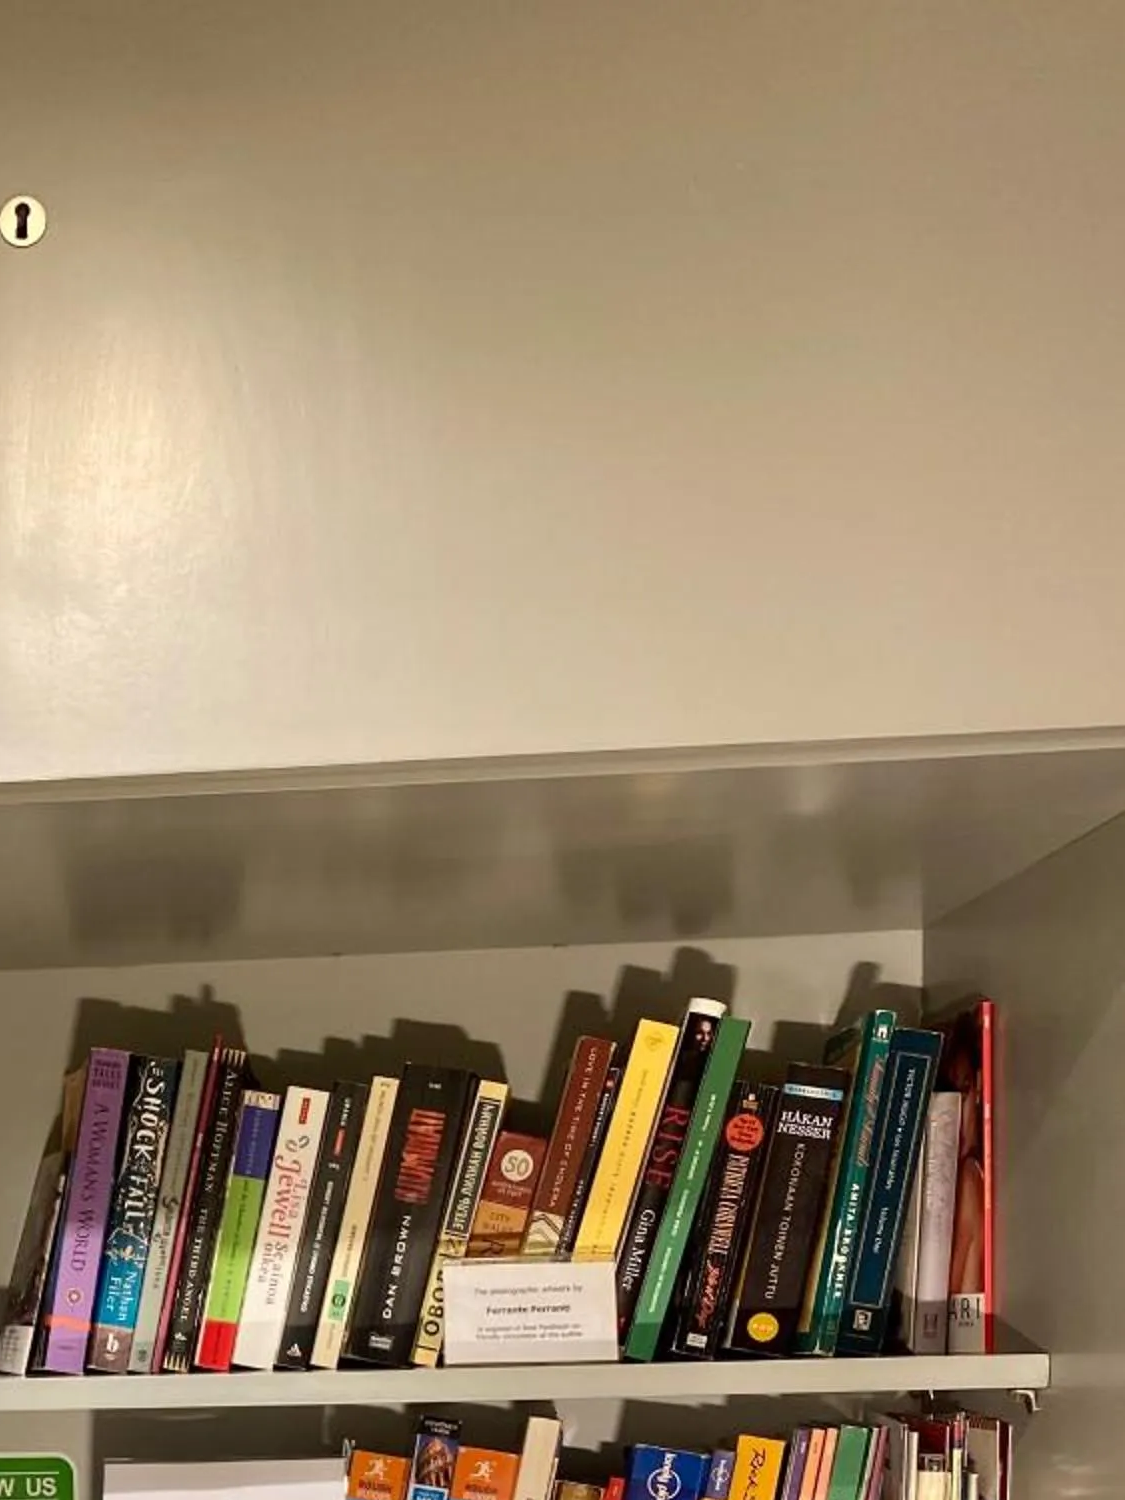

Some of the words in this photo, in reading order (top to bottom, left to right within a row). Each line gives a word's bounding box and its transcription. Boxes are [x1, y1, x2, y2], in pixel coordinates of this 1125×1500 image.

[583, 1047, 596, 1074] LOVE
[215, 1070, 238, 1118] ALICE
[132, 1077, 166, 1162] SHOCK
[566, 1115, 578, 1139] TIME
[777, 1122, 832, 1141] NESSER
[781, 1109, 834, 1128] HÅKAN
[203, 1119, 229, 1194] HOFFMAN
[646, 1104, 689, 1190] RISE
[123, 1174, 149, 1218] FALL
[268, 1154, 302, 1239] Jewell
[549, 1159, 567, 1208] CHOLERA
[783, 1143, 806, 1212] KOKONAAN
[69, 1208, 94, 1272] WORLD
[390, 1214, 413, 1278] BROWN
[633, 1208, 656, 1245] Gina
[773, 1213, 792, 1261] TOINEN
[621, 1248, 643, 1290] Miller
[764, 1262, 781, 1299] JUTTU
[105, 1276, 124, 1314] Filer
[118, 1270, 139, 1322] Nathan
[382, 1282, 400, 1320] DAN
[25, 1476, 57, 1497] US
